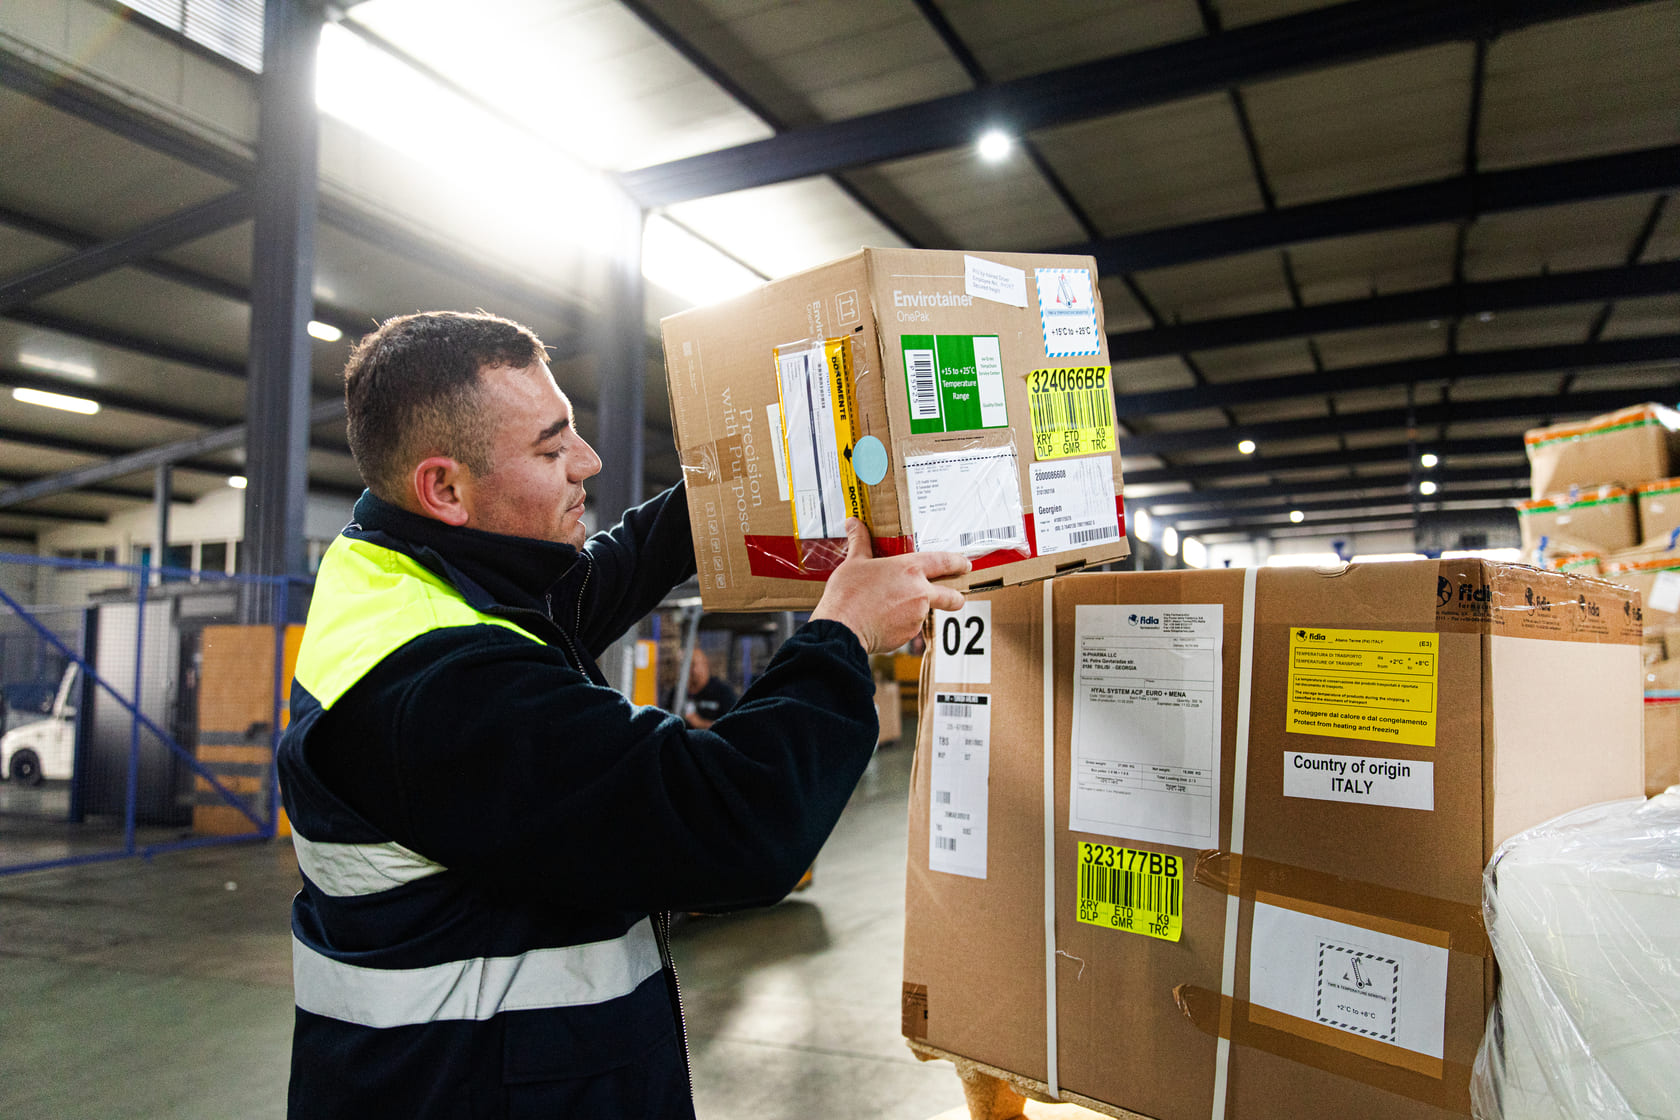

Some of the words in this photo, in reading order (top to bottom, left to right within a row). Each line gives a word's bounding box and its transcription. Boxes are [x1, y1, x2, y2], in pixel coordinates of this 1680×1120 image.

[893, 290, 973, 307] Envirotainer
[813, 300, 824, 341] Enviro
[896, 310, 929, 322] OnePak
[1068, 327, 1074, 335] to
[952, 367, 959, 375] to
[1032, 367, 1105, 393] 324066BB
[831, 356, 847, 421] DOKUMENTE
[942, 380, 976, 388] Temperature
[952, 392, 970, 401] Range
[721, 386, 739, 437] with
[1036, 433, 1052, 445] XRY
[1064, 430, 1079, 442] ETD
[1096, 428, 1105, 438] K9
[1038, 445, 1053, 457] DLP
[1063, 442, 1080, 454] GMR
[1091, 439, 1106, 451] TRC
[740, 408, 763, 507] Precision
[728, 445, 750, 534] Purpose
[848, 486, 859, 518] DOCU
[1038, 505, 1062, 515] Georgien
[1459, 584, 1492, 602] fidi
[1140, 616, 1159, 625] fidia
[943, 616, 984, 655] 02
[1309, 632, 1326, 640] fidia
[1294, 708, 1328, 717] Proteggere
[1379, 716, 1428, 726] congelamento
[1317, 720, 1332, 728] from
[1333, 722, 1357, 731] heating
[1372, 726, 1399, 735] freezing
[1294, 755, 1347, 775] Country
[1351, 760, 1366, 774] of
[1369, 762, 1411, 780] origin
[1331, 778, 1374, 795] ITALY
[1084, 843, 1178, 877] 323177BB
[1080, 899, 1099, 911] XRY
[1115, 906, 1134, 918] ETD
[1157, 913, 1170, 926] K9
[1080, 910, 1099, 921] DLP
[1111, 915, 1134, 929] GMR
[1148, 922, 1169, 937] TRC
[1337, 1004, 1352, 1013] +2°C
